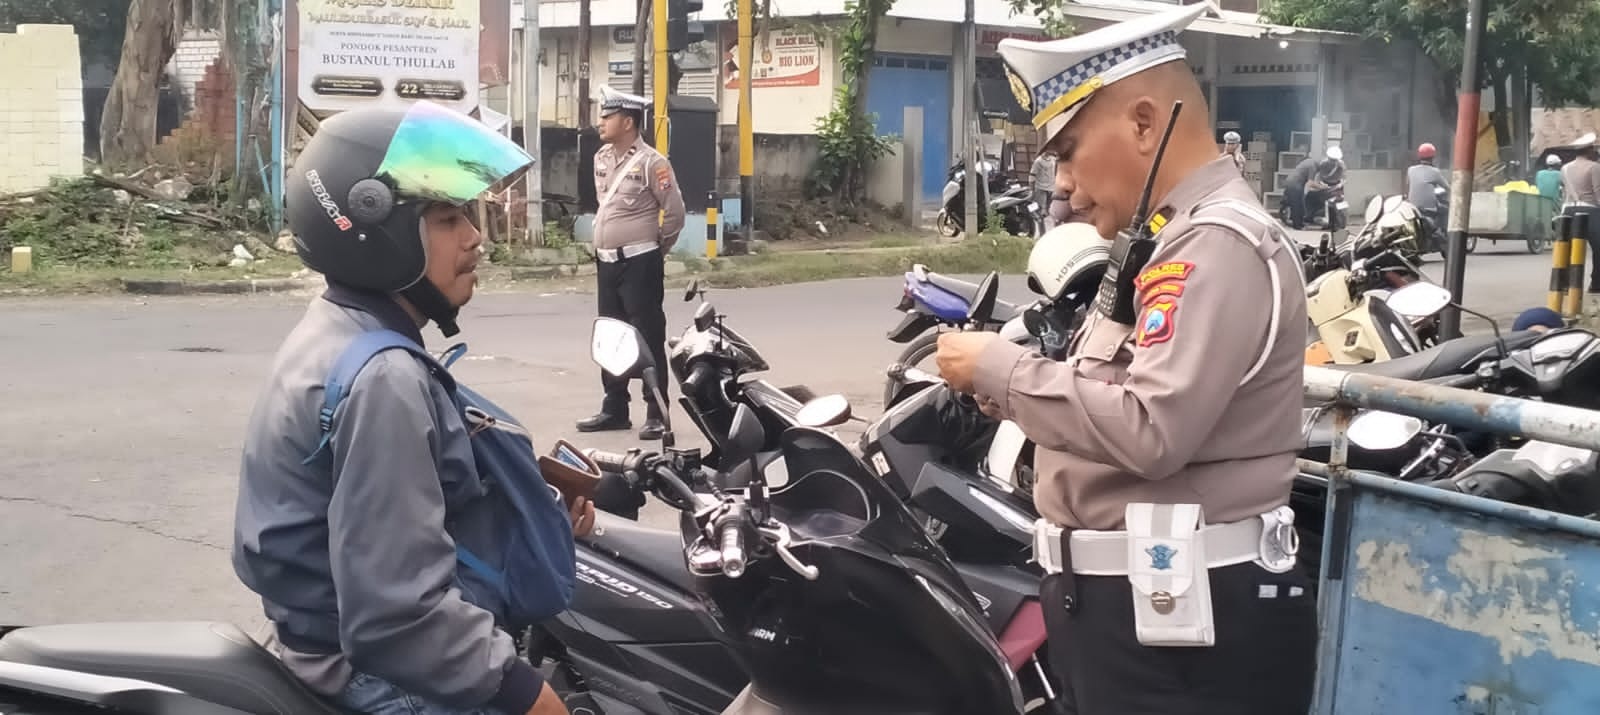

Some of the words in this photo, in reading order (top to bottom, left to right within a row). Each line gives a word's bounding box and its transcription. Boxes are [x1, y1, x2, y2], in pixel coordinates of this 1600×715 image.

[340, 42, 382, 51] PONDOK
[383, 44, 437, 54] PESANTREN
[322, 54, 391, 67] BUSTANUL
[393, 56, 456, 69] THULLAB
[794, 55, 815, 66] LION
[400, 83, 418, 94] 22
